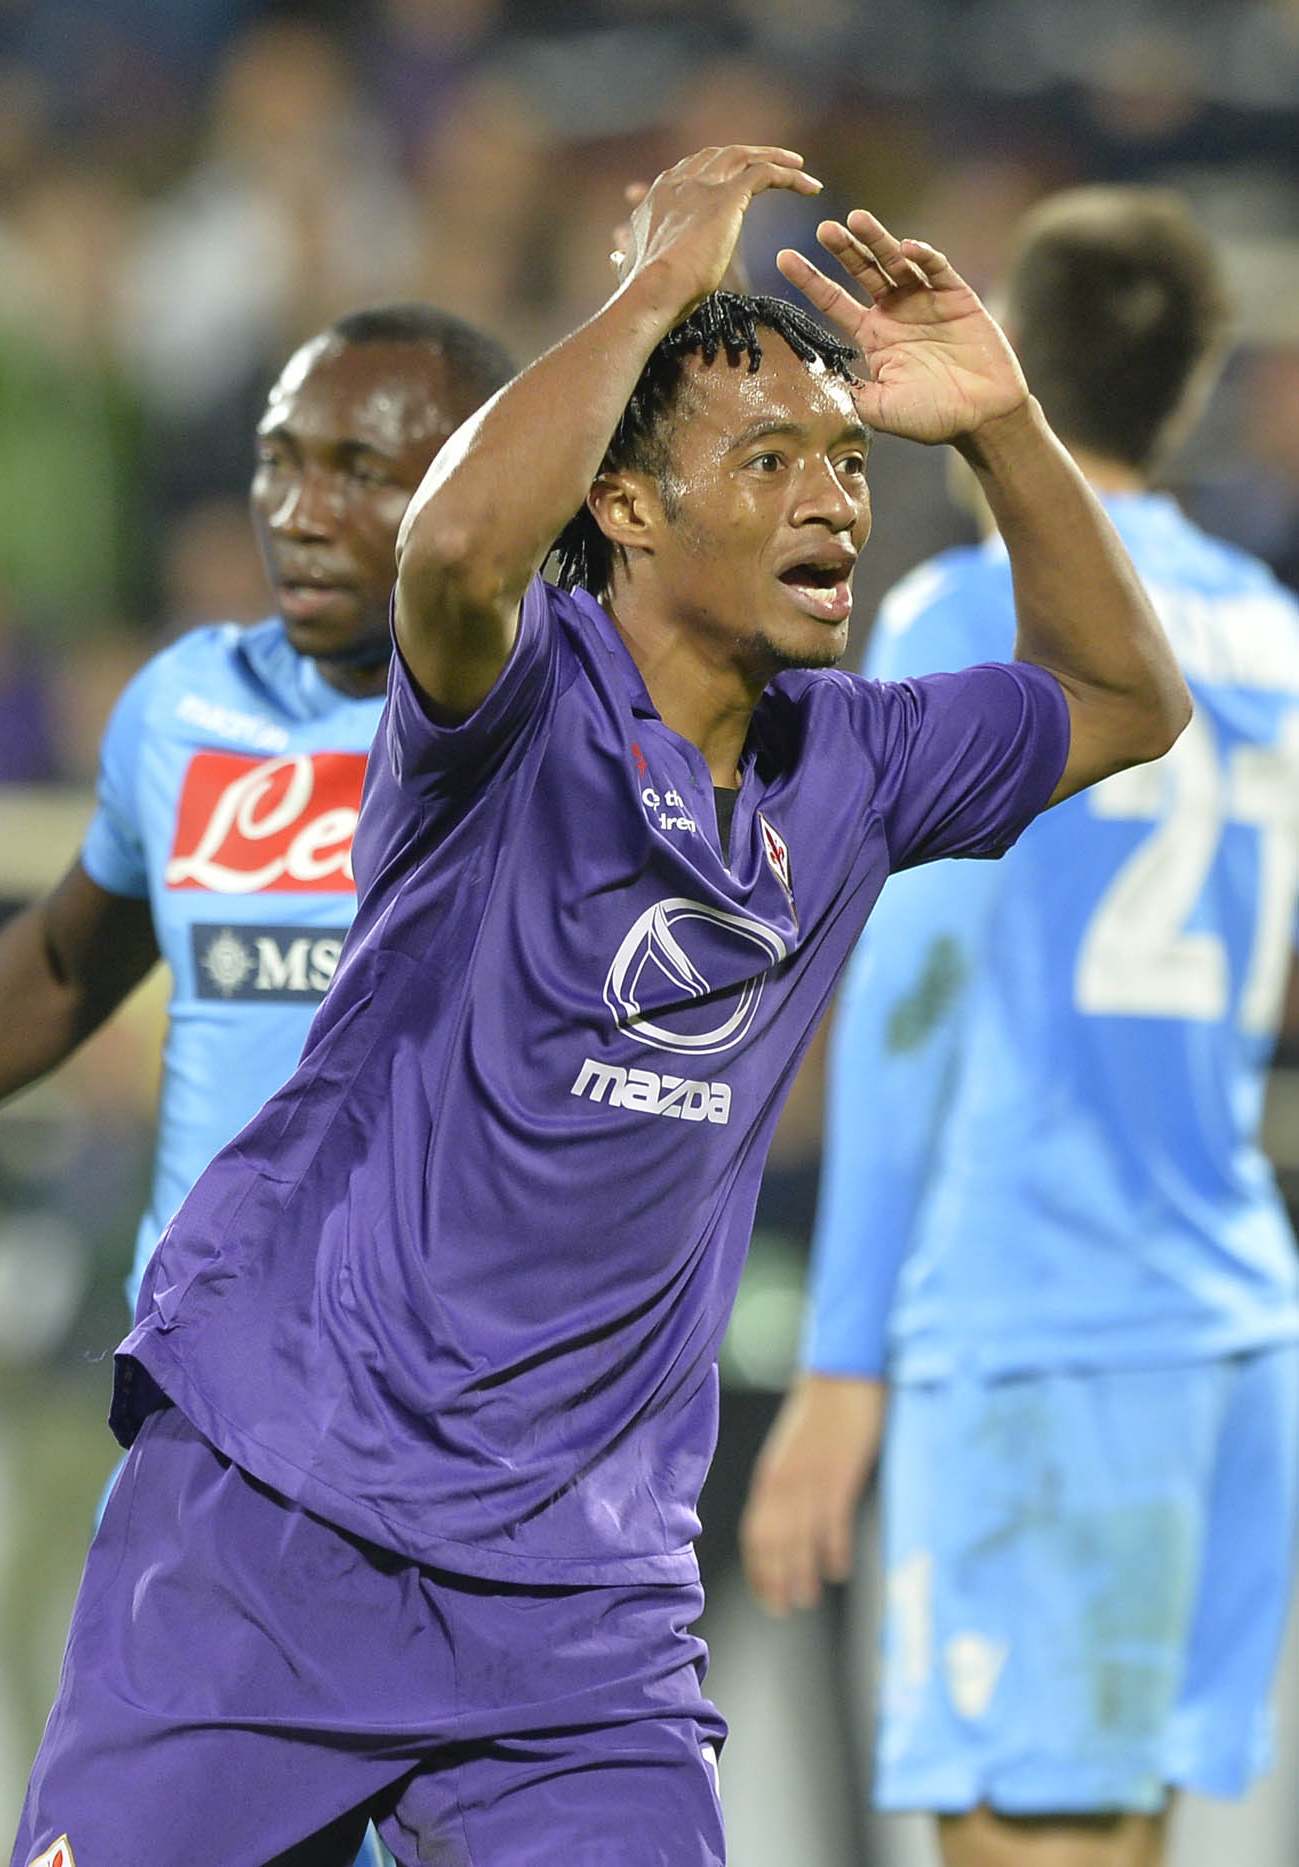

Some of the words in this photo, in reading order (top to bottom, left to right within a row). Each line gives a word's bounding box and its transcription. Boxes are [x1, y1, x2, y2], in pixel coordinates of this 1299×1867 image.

[164, 754, 361, 894] Le
[664, 789, 685, 808] th
[254, 936, 349, 992] MS
[570, 1057, 732, 1125] mazda
